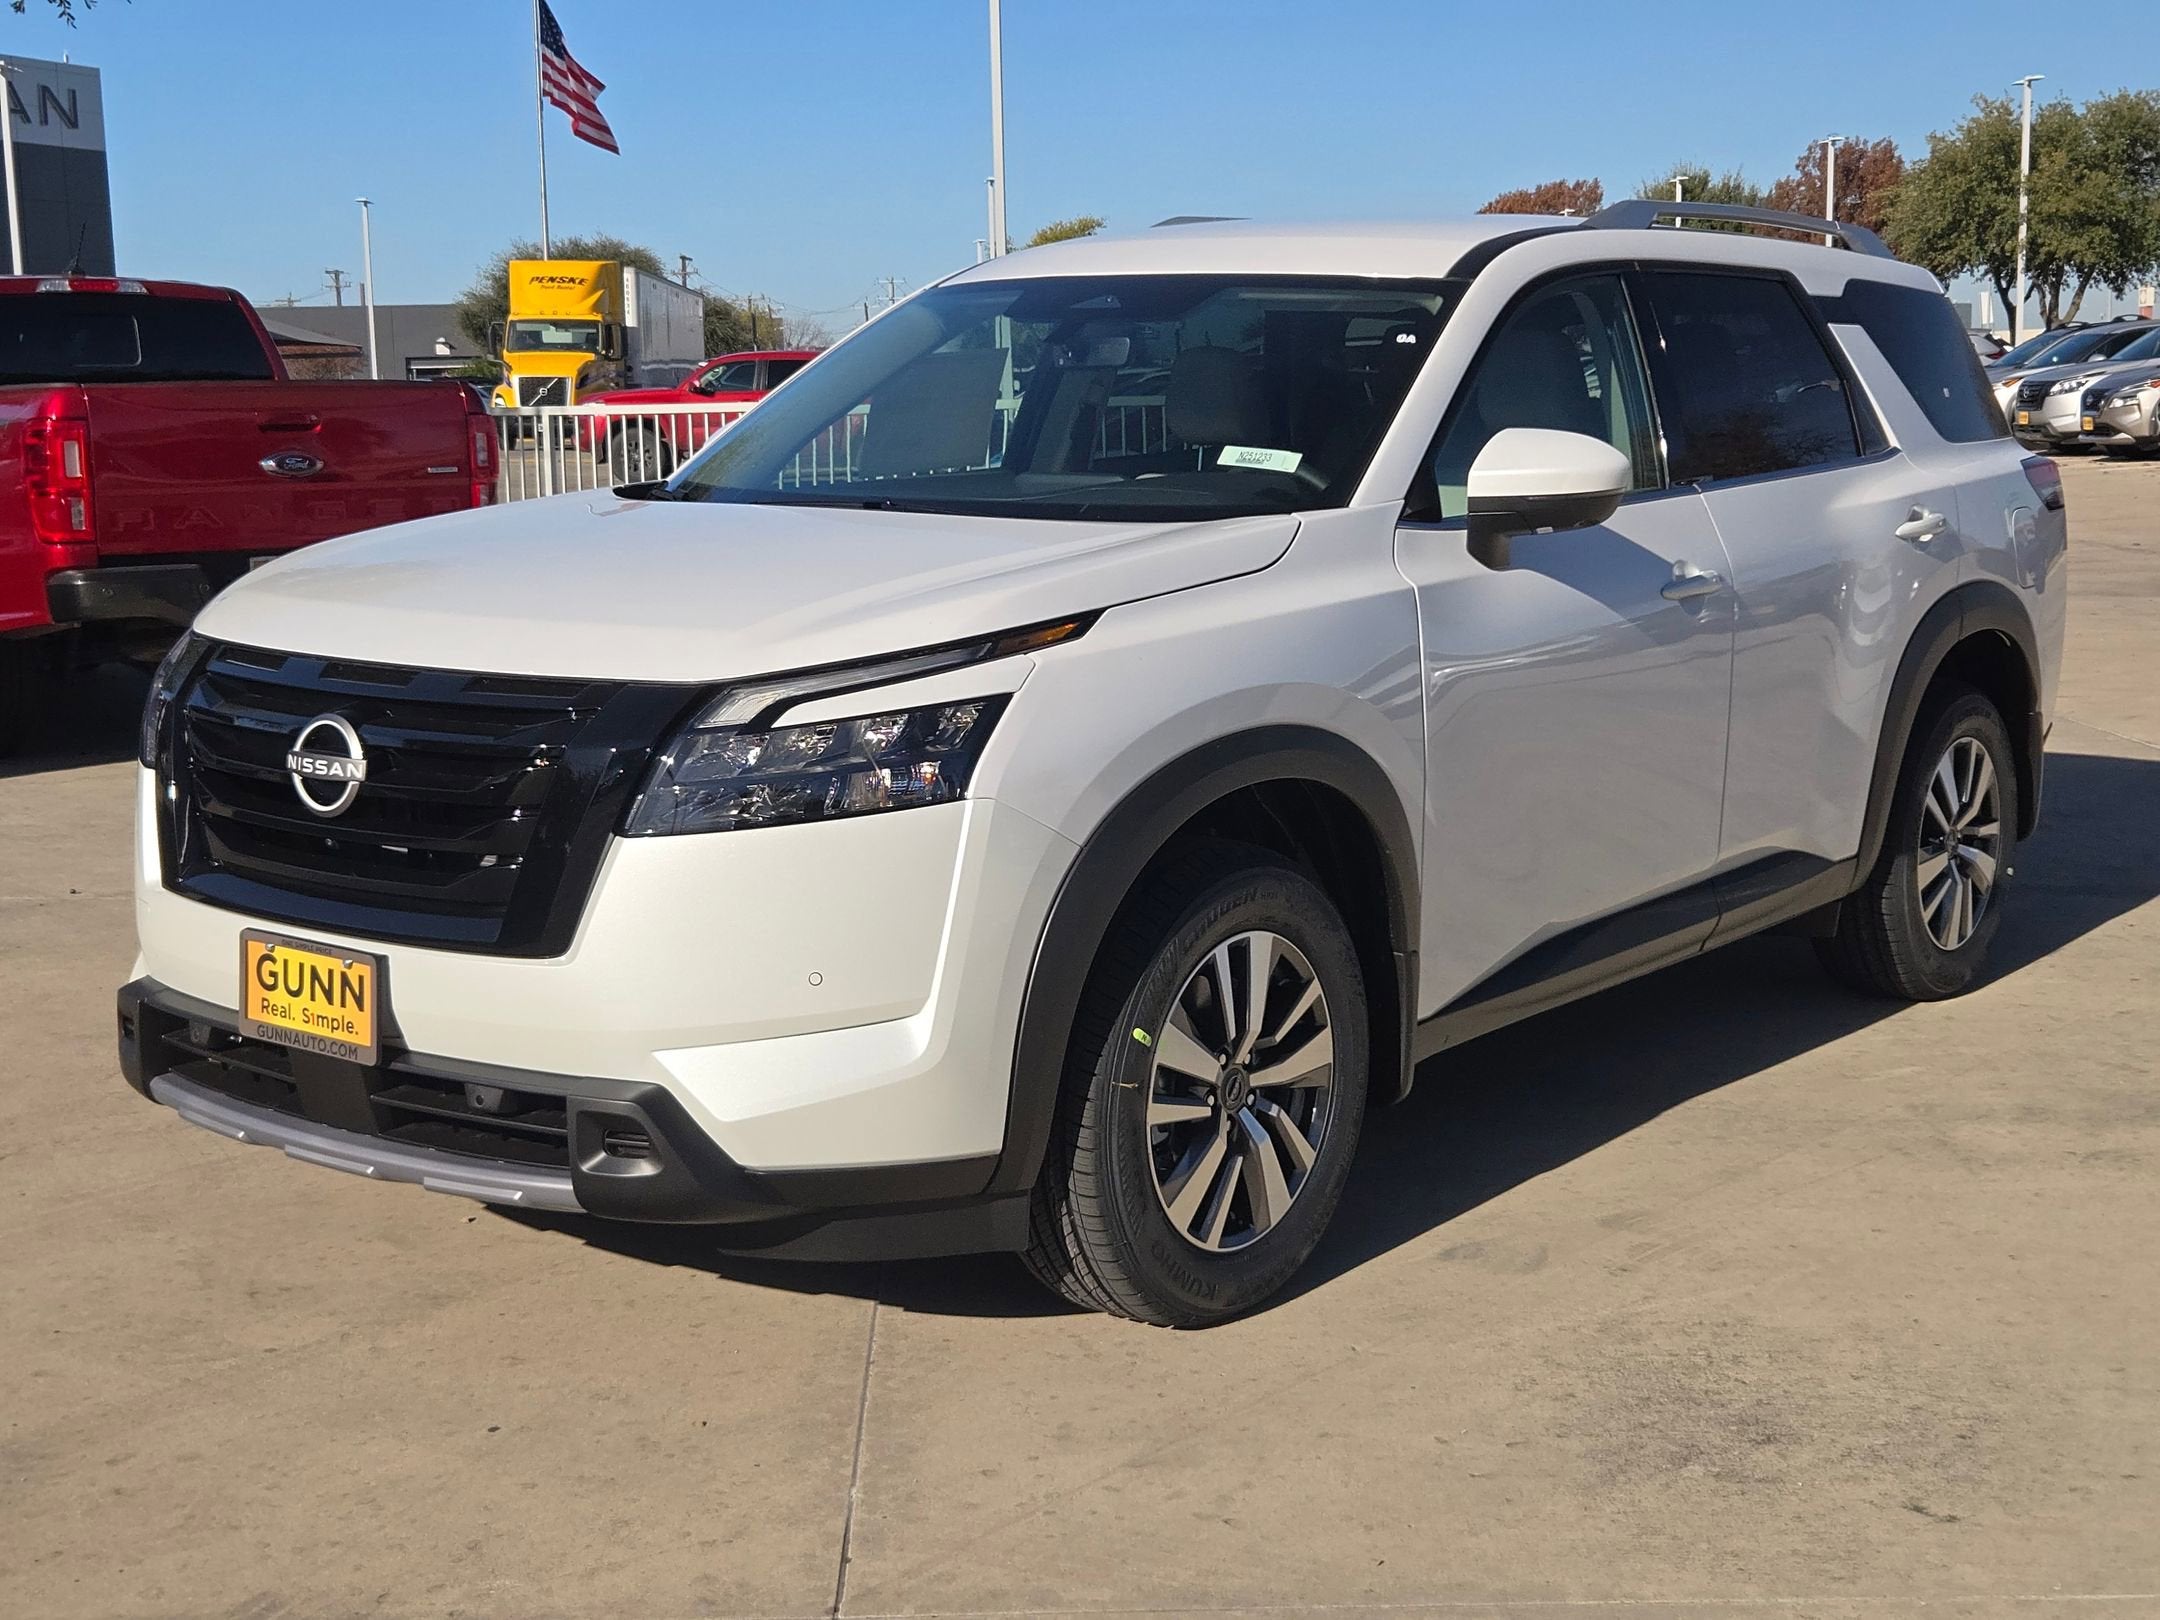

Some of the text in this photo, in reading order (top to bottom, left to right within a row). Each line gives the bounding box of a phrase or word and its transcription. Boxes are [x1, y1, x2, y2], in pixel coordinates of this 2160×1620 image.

[529, 276, 588, 285] PENSKE
[1239, 450, 1272, 462] N251233
[287, 754, 363, 779] NISSAN
[256, 953, 365, 1012] GUNN
[261, 997, 295, 1021] Real.
[257, 1024, 358, 1060] GUNNAUTO.COM
